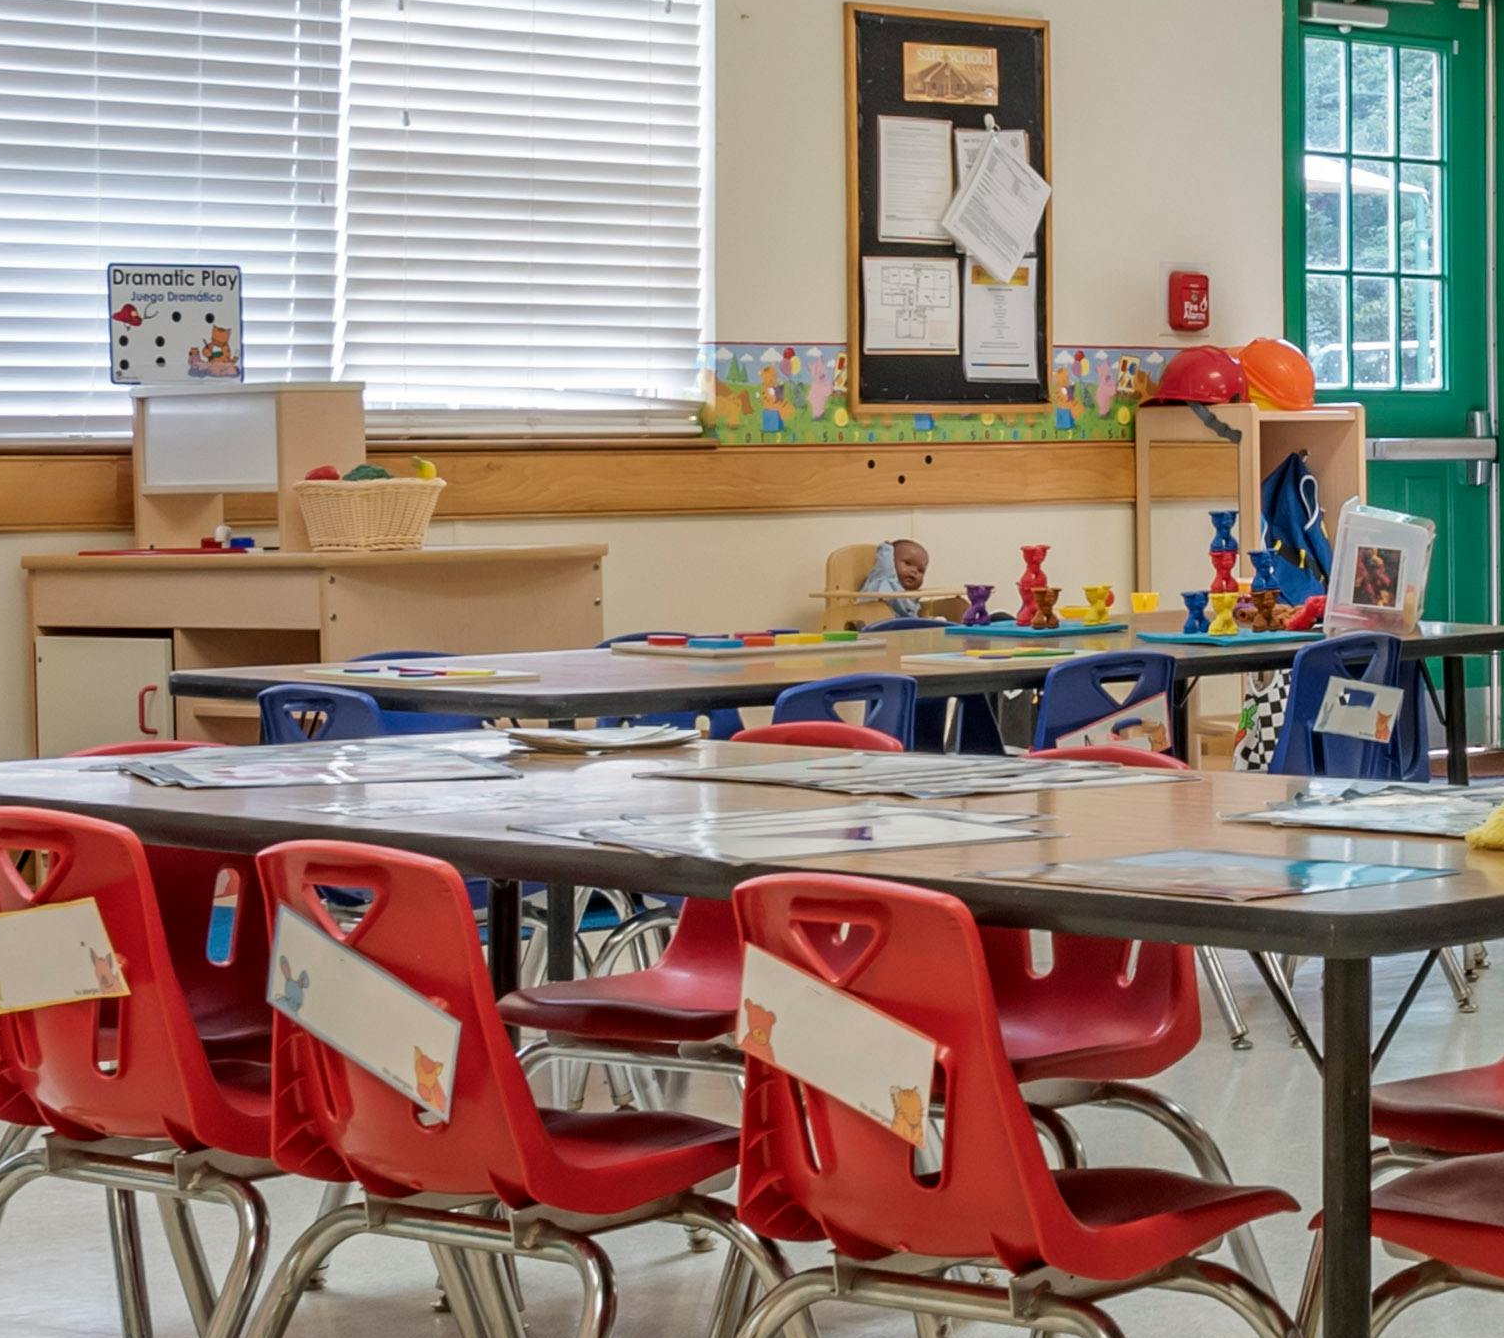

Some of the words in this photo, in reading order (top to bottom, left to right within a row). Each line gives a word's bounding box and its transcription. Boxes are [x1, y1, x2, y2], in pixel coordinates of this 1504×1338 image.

[112, 269, 195, 286] Dramatic
[202, 270, 238, 290] Play
[130, 291, 164, 303] Juego
[167, 290, 223, 303] Dramático
